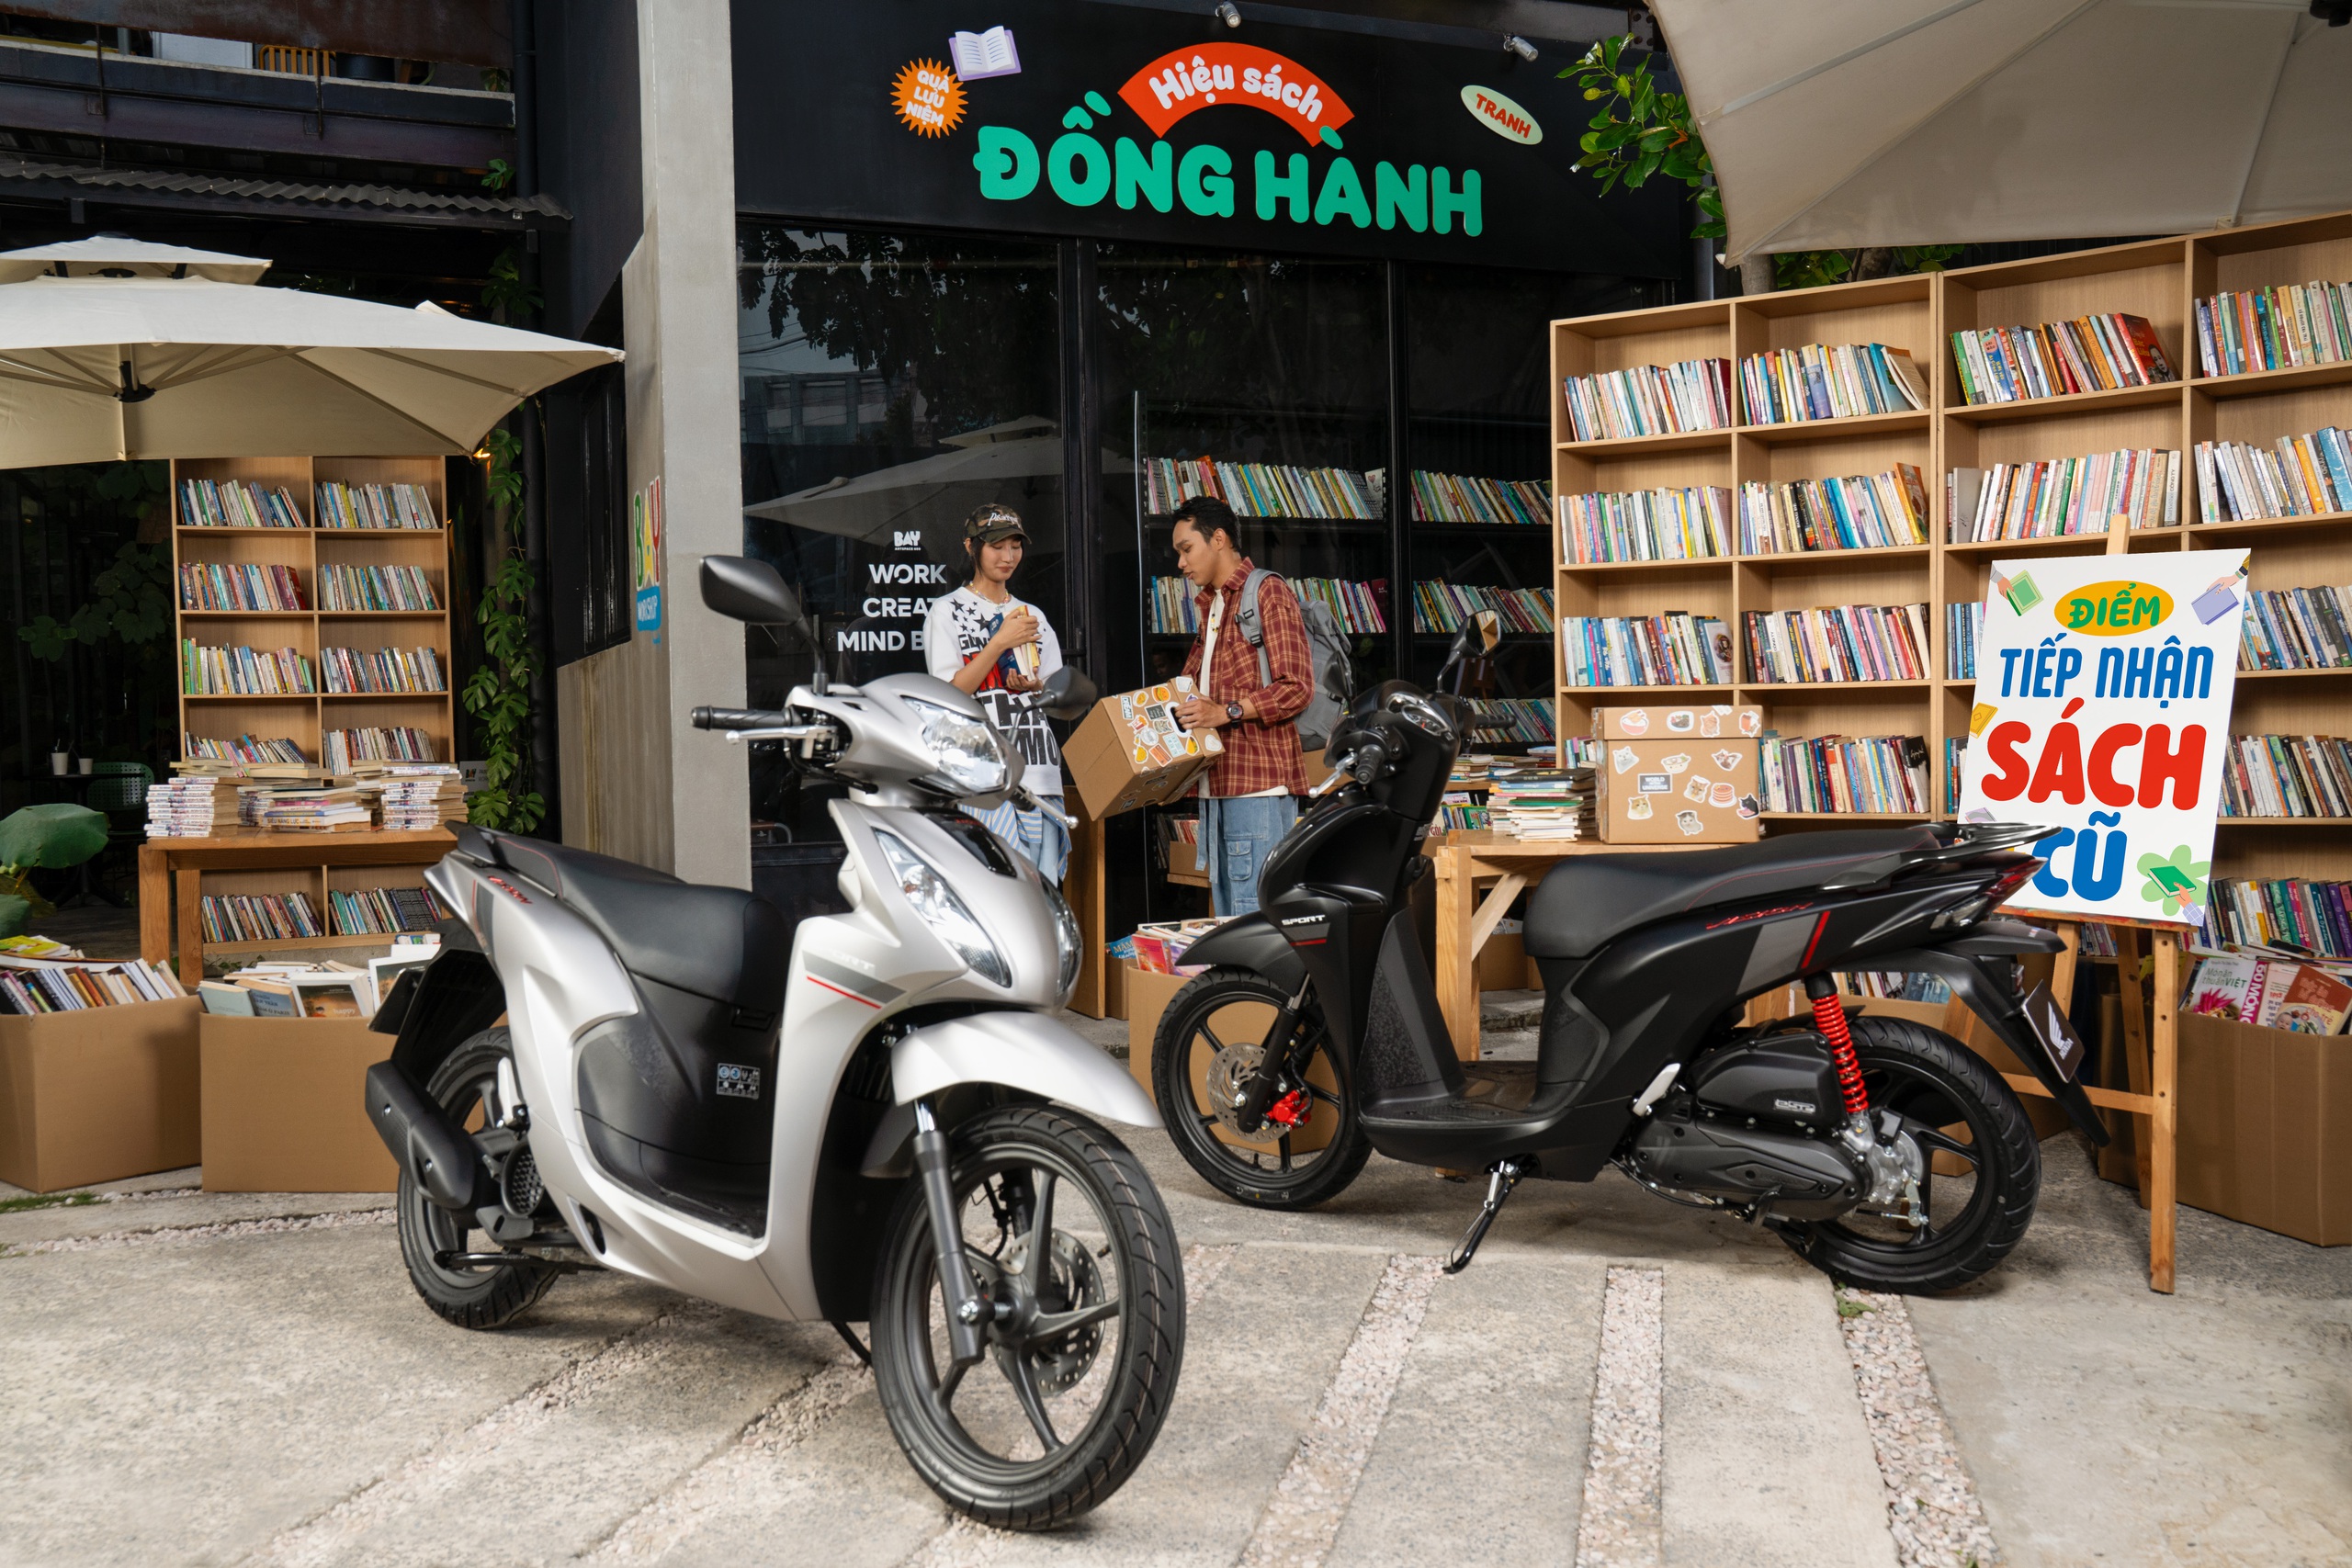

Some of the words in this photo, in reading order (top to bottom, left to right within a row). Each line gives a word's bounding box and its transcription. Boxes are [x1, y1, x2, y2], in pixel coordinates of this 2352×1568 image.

[913, 86, 944, 108] LƯU
[917, 70, 949, 94] QUÀ
[1149, 55, 1235, 109] Hiệu
[1242, 64, 1323, 122] sách
[905, 101, 944, 127] NIỆM
[1476, 93, 1532, 139] TRANH
[972, 90, 1235, 218] ĐỒNG
[1255, 125, 1482, 237] HÀNH
[634, 474, 661, 592] BAY
[893, 530, 921, 547] BAY
[868, 563, 947, 584] WORK
[2067, 583, 2160, 628] ĐIỂM
[837, 630, 906, 652] MIND
[1999, 632, 2083, 698] TIẾP
[2095, 635, 2214, 709] NHẬN
[1981, 696, 2207, 811] SÁCH
[2031, 810, 2128, 902] CŨ
[1282, 914, 1326, 926] SPORT
[2223, 976, 2248, 989] VIỆT
